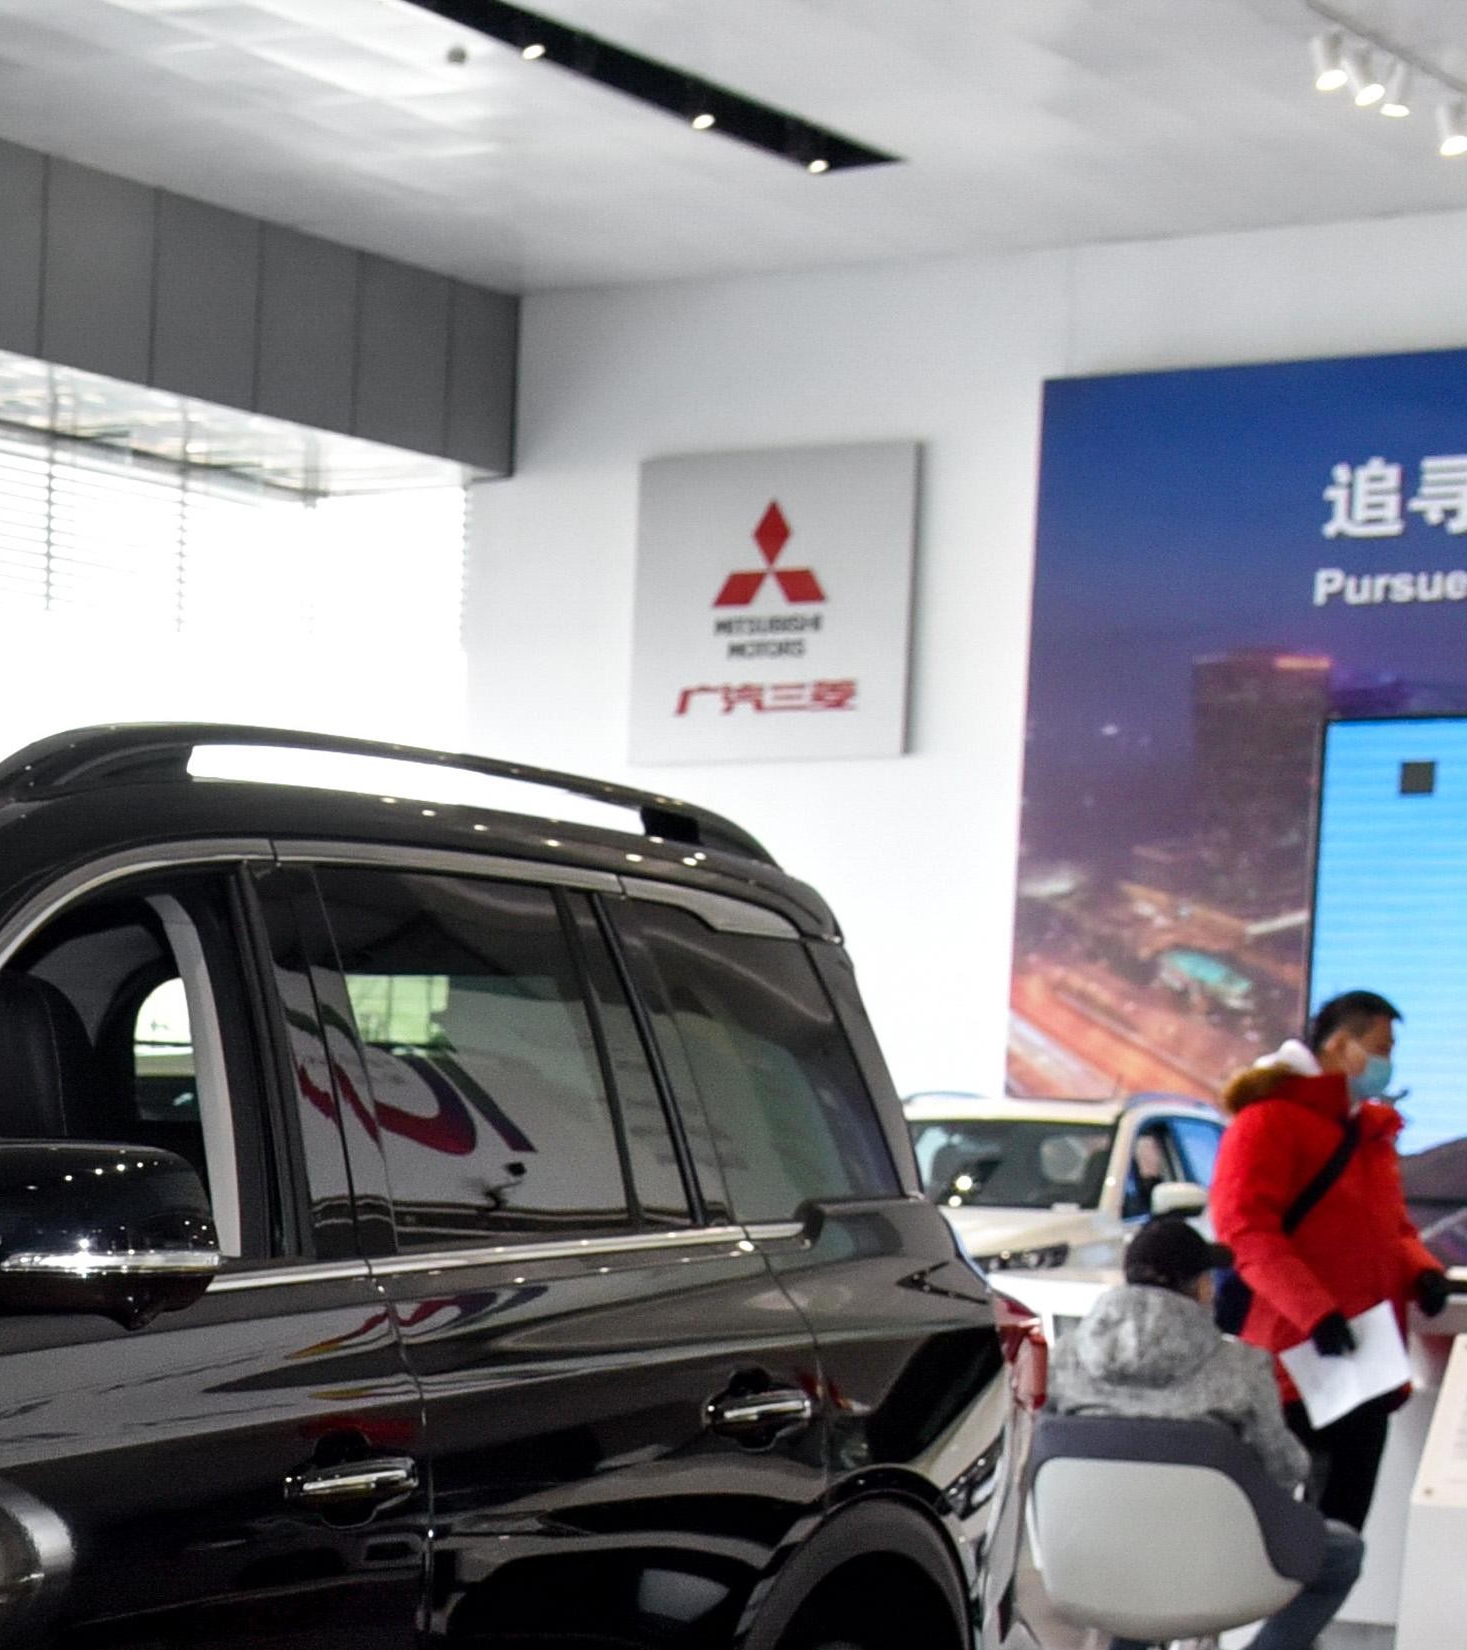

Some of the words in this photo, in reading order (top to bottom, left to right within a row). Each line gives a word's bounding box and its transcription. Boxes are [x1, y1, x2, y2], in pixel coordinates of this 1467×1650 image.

[1323, 455, 1467, 539] 追寻
[1313, 567, 1467, 606] Pursue
[714, 613, 823, 636] MITSUBISHI
